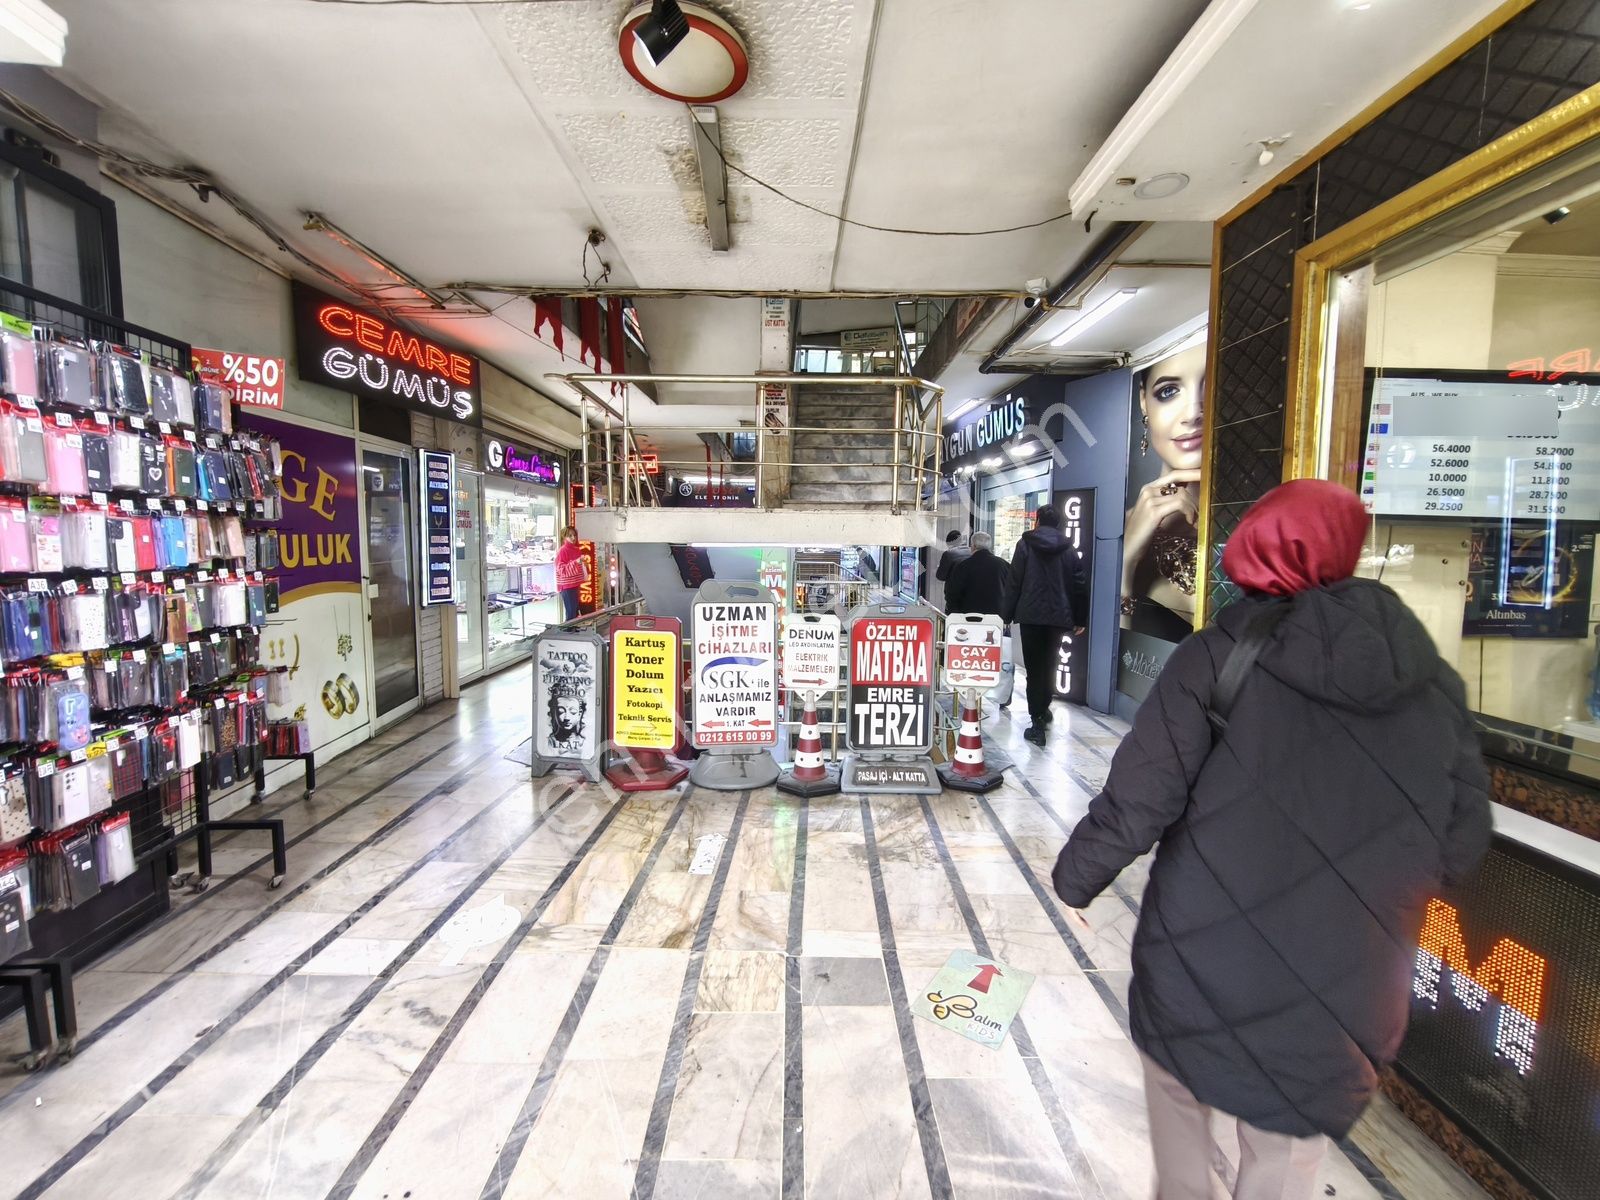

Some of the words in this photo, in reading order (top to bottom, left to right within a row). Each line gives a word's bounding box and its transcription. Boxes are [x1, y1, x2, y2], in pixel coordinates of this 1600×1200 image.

[319, 306, 471, 385] CEMRE
[222, 354, 279, 387] %50
[322, 347, 474, 419] GÜMÜŞ
[976, 393, 1026, 440] GÜMÜŞ
[1432, 444, 1472, 454] 56.4000
[1535, 446, 1575, 457] 58.2000
[1430, 459, 1470, 468] 52.6000
[1533, 461, 1572, 471] 54.800
[1428, 473, 1467, 483] 10.0000
[280, 450, 340, 522] GE
[1426, 487, 1465, 497] 26.5000
[1424, 502, 1463, 512] 29.2500
[279, 533, 353, 568] ULUK
[702, 606, 767, 622] UZMAN
[711, 623, 759, 641] İŞİTME
[789, 628, 835, 641] DENUM
[865, 622, 918, 641] ÖZLEM
[625, 637, 666, 651] Kartuş
[698, 639, 772, 655] CİHAZLARI
[546, 650, 588, 662] TATTOO
[625, 653, 665, 665] Toner
[960, 646, 989, 659] ÇAY
[856, 640, 928, 683] MATBAA
[951, 658, 996, 671] OCAĞI
[562, 663, 570, 674] &
[625, 669, 664, 680] Dolum
[626, 684, 664, 694] Yazıcı
[757, 678, 770, 688] ile
[699, 691, 772, 704] ANLAŞMAMIZ
[867, 687, 914, 703] EMRE
[626, 700, 663, 711] Fotokopi
[715, 706, 756, 717] VARDIR
[617, 713, 645, 722] Teknik
[647, 714, 673, 723] Servis
[733, 719, 746, 727] KAT
[854, 693, 924, 746] TERZİ
[699, 731, 723, 743] 0212
[725, 731, 744, 742] 615
[746, 730, 758, 742] 00
[760, 730, 772, 741] 99
[857, 771, 878, 782] PASAJ
[892, 771, 904, 781] ALT
[904, 771, 926, 783] KATTA
